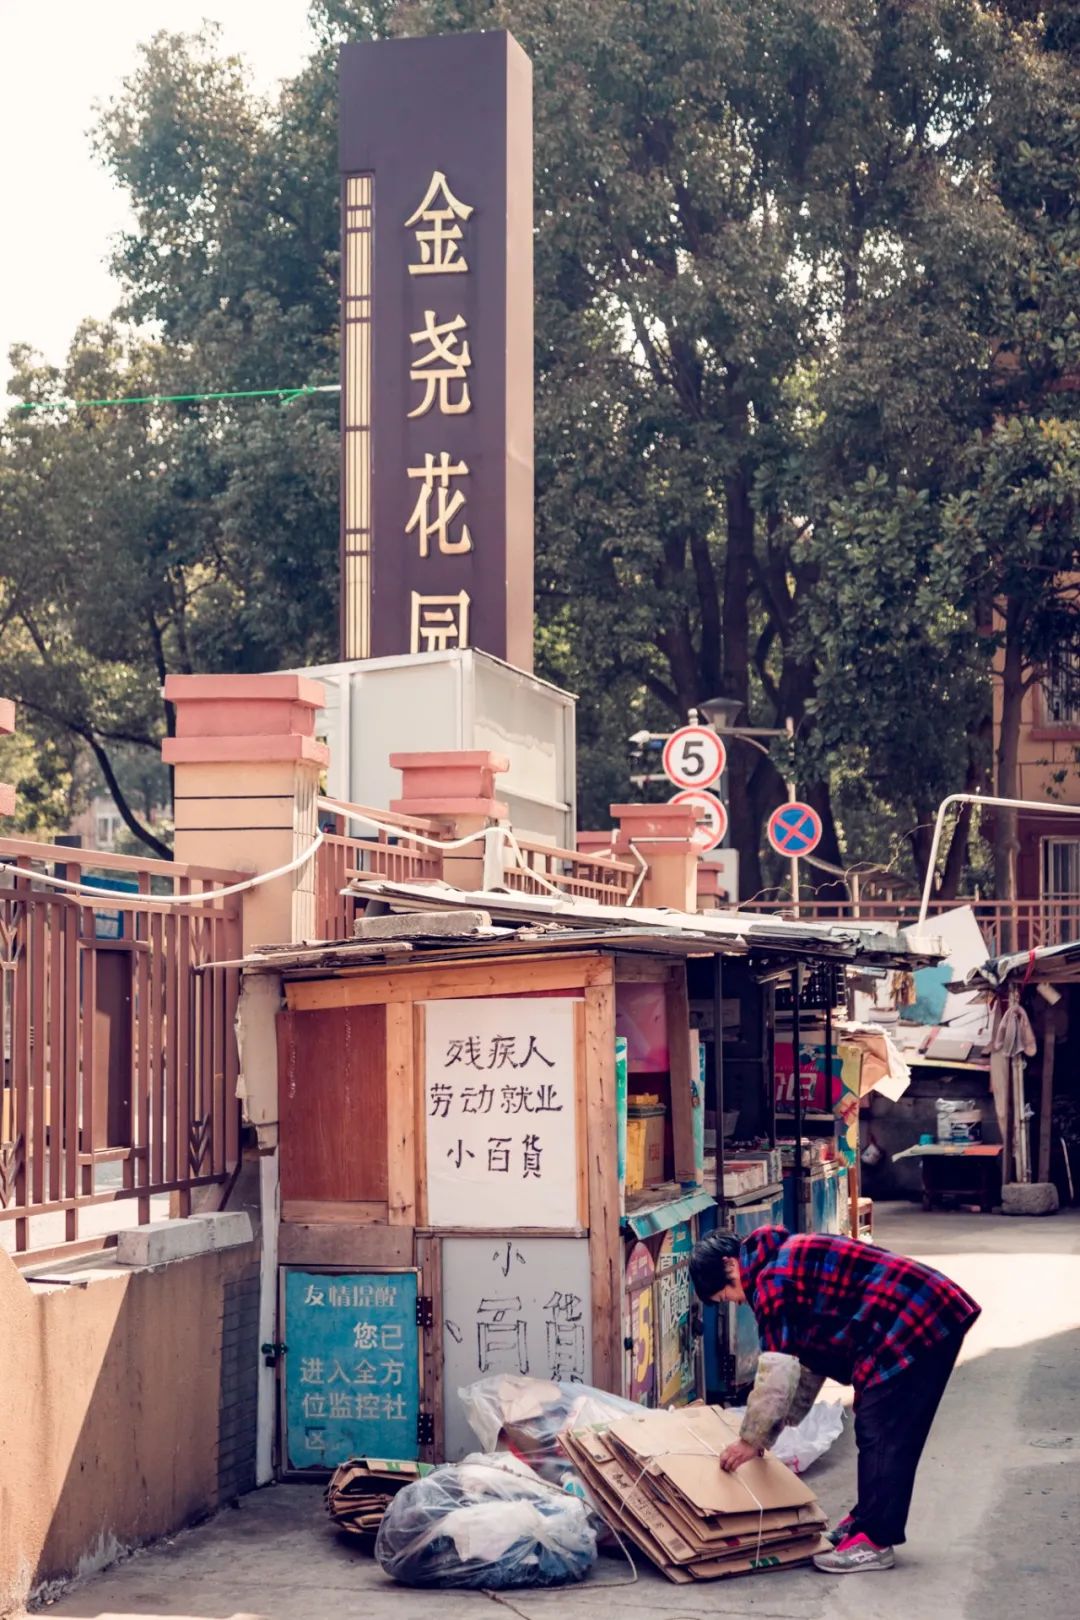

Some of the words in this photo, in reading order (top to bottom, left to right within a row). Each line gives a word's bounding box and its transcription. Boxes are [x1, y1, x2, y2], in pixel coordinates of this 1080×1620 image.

[404, 170, 474, 654] 金尧花园
[681, 740, 705, 777] 5
[444, 1034, 556, 1070] 残疾人
[429, 1083, 563, 1118] 劳动就业
[304, 1284, 398, 1308] 友情提醒
[353, 1321, 405, 1350] 您已
[300, 1357, 405, 1386] 进入全方
[302, 1392, 408, 1421] 位监控社
